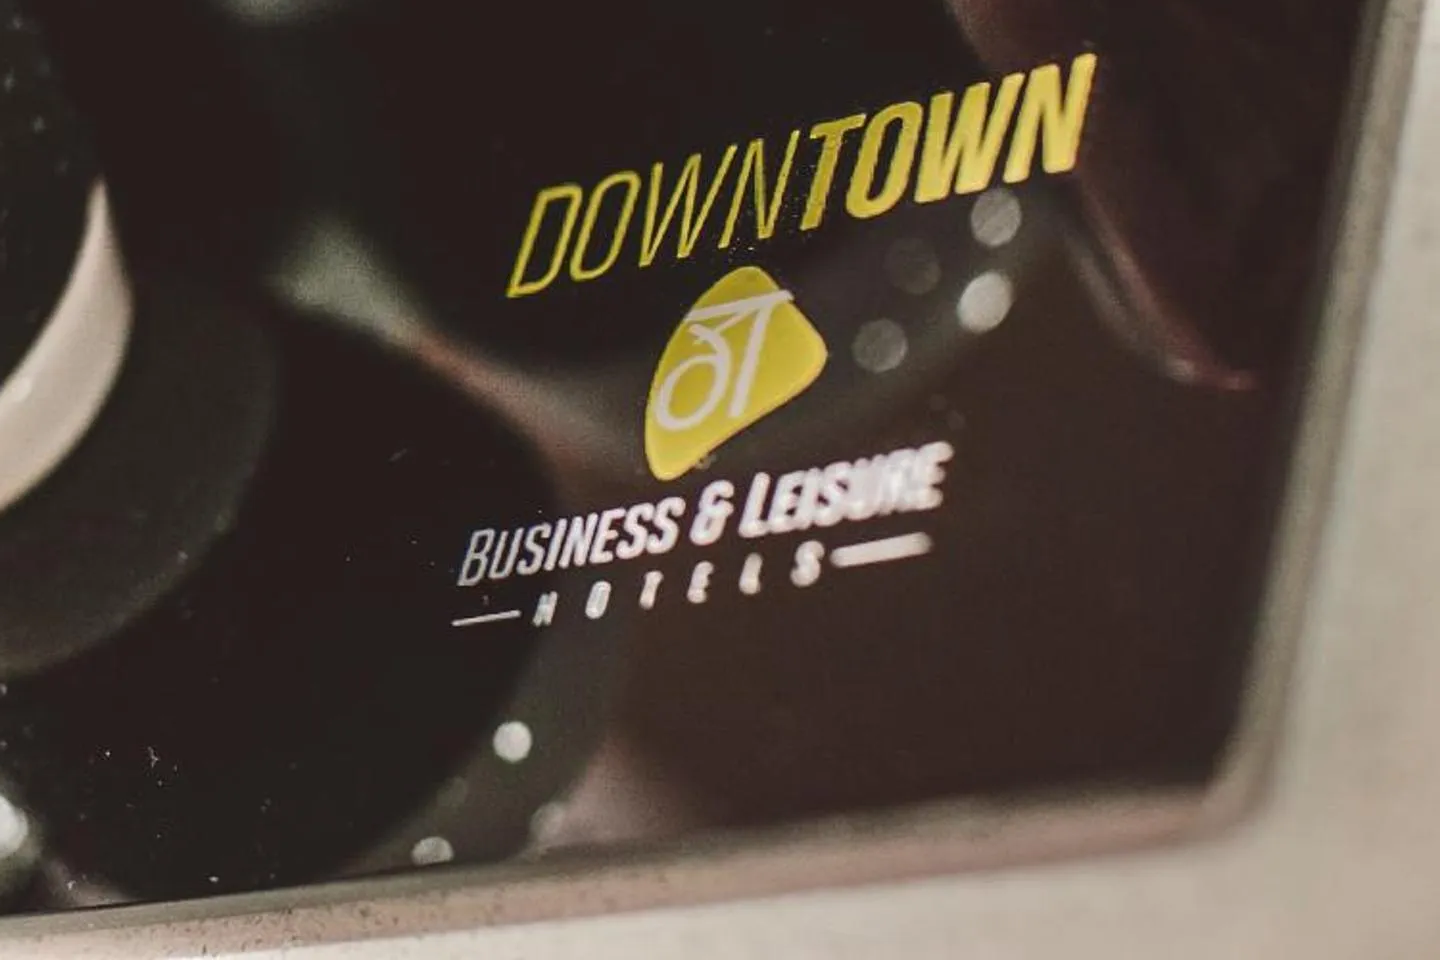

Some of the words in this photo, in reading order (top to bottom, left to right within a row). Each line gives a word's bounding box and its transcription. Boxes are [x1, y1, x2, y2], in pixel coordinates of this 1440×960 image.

[506, 53, 1097, 298] DOWNTOWN
[457, 497, 685, 587] BUSINESS
[689, 478, 733, 546] &
[739, 441, 953, 539] LEISURE
